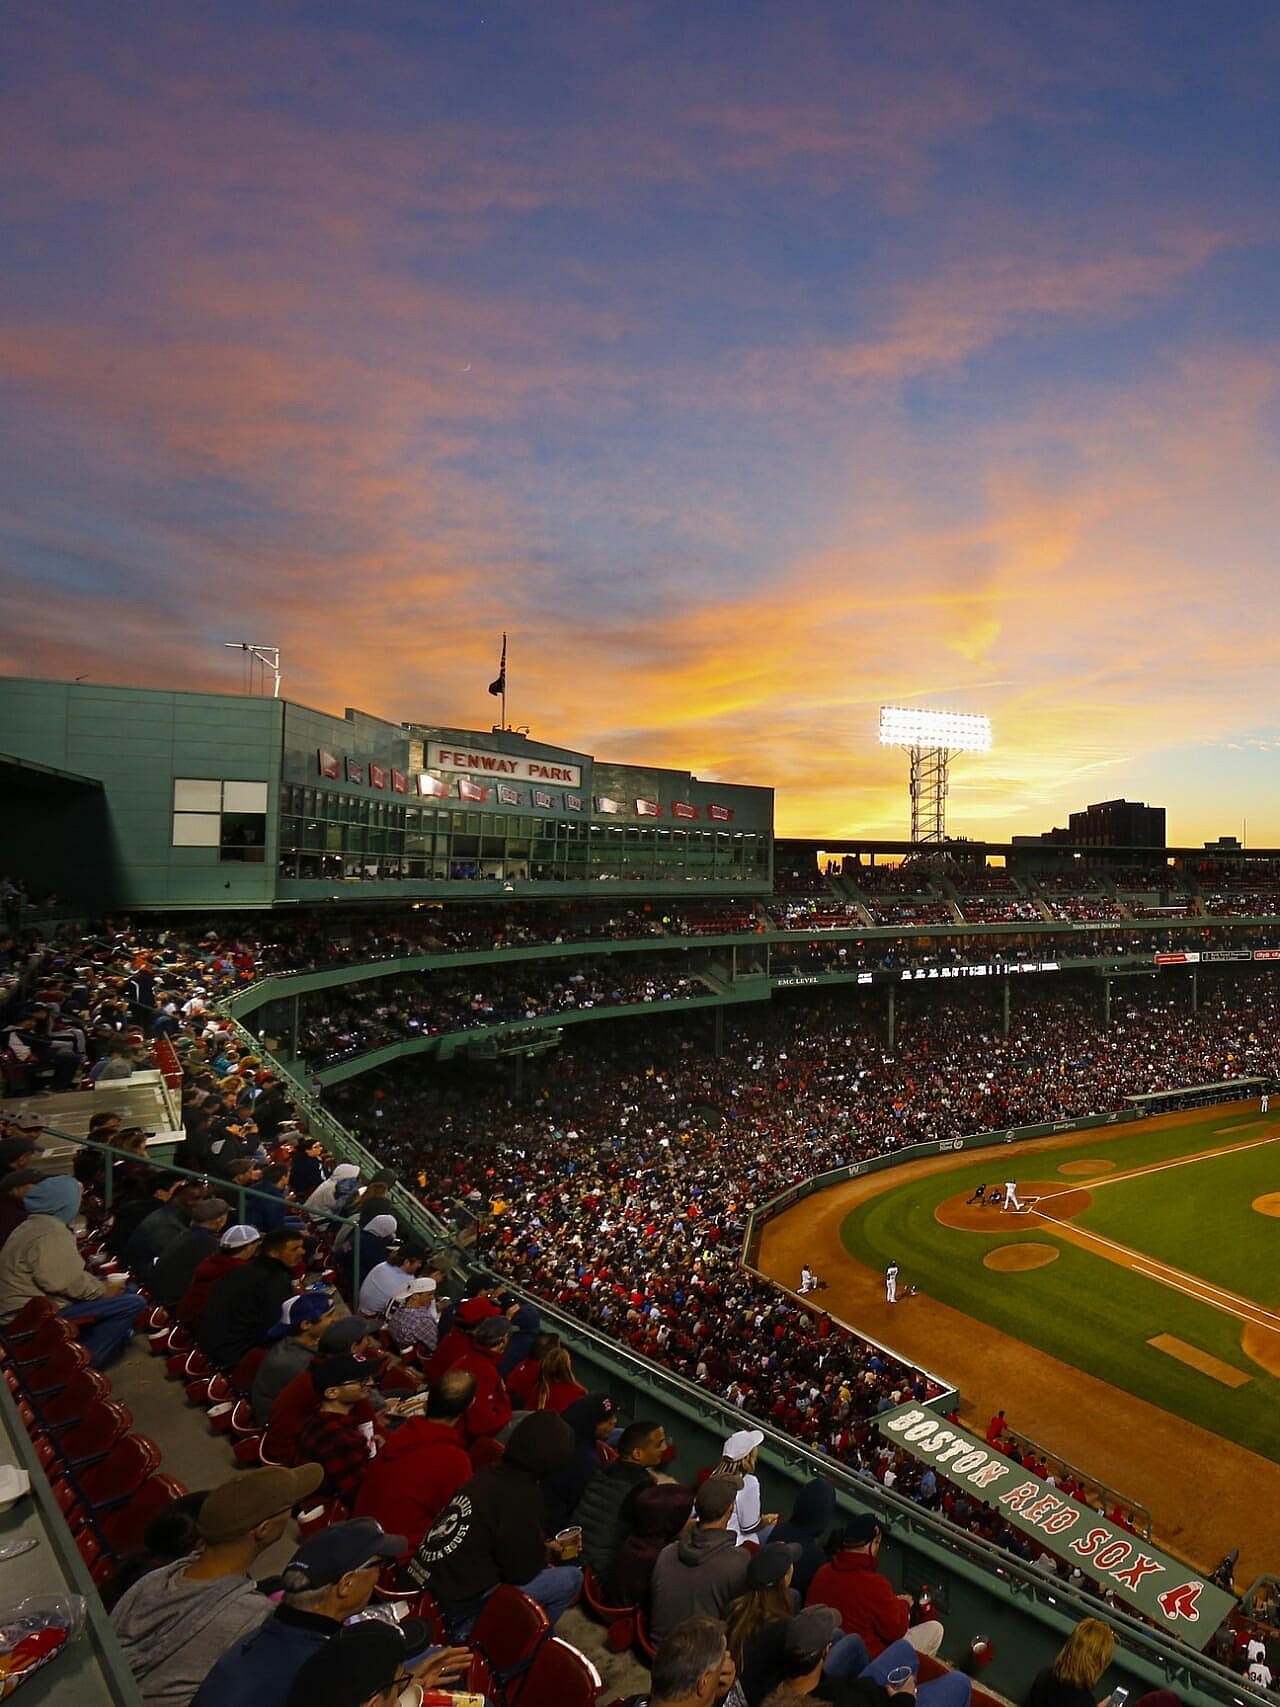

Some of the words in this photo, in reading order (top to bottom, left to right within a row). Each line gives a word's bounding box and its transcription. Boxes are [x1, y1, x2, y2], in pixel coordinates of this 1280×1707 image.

[439, 749, 519, 774] FENWAY
[528, 763, 573, 783] PARK
[796, 977, 819, 985] LEVEL
[887, 1409, 1010, 1488] BOSTON
[998, 1480, 1082, 1535] RED
[1068, 1527, 1166, 1593] SOX
[443, 1524, 470, 1555] HOUSE
[1250, 1671, 1262, 1683] 34
